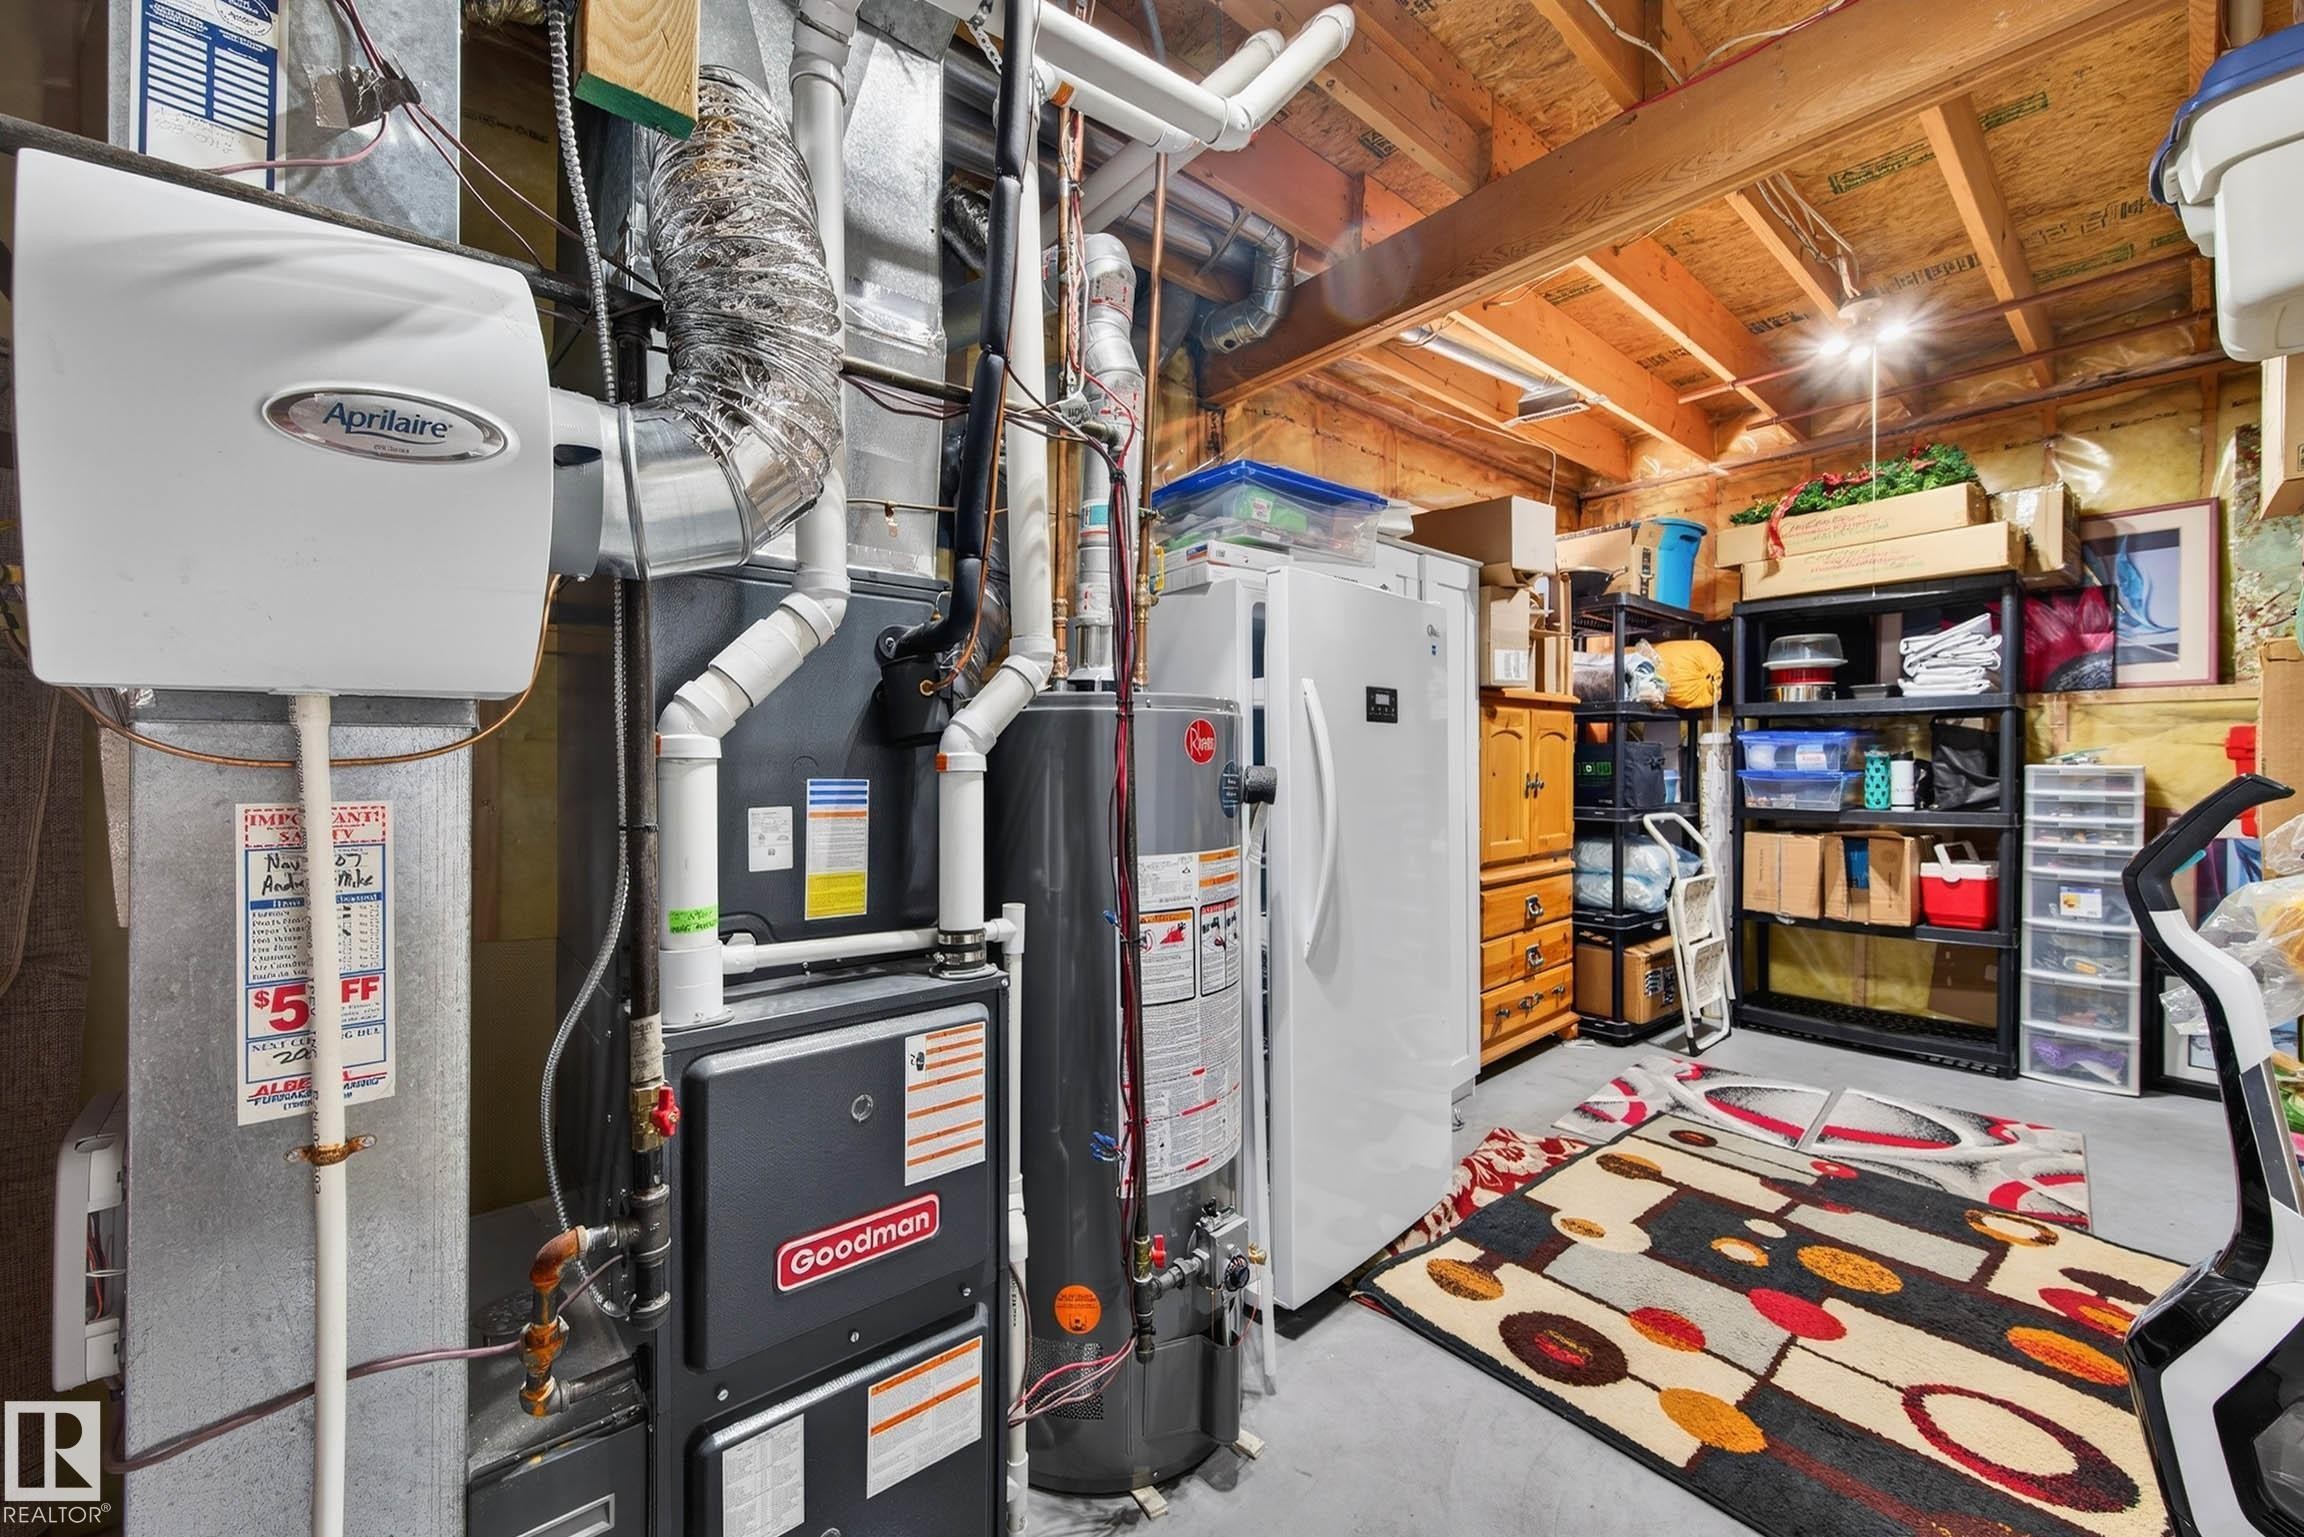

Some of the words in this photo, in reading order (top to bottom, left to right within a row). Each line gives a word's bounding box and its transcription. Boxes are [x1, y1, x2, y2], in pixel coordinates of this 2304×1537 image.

[322, 401, 449, 439] Aprilaire
[340, 976, 380, 1004] FF
[790, 1211, 930, 1275] Goodman
